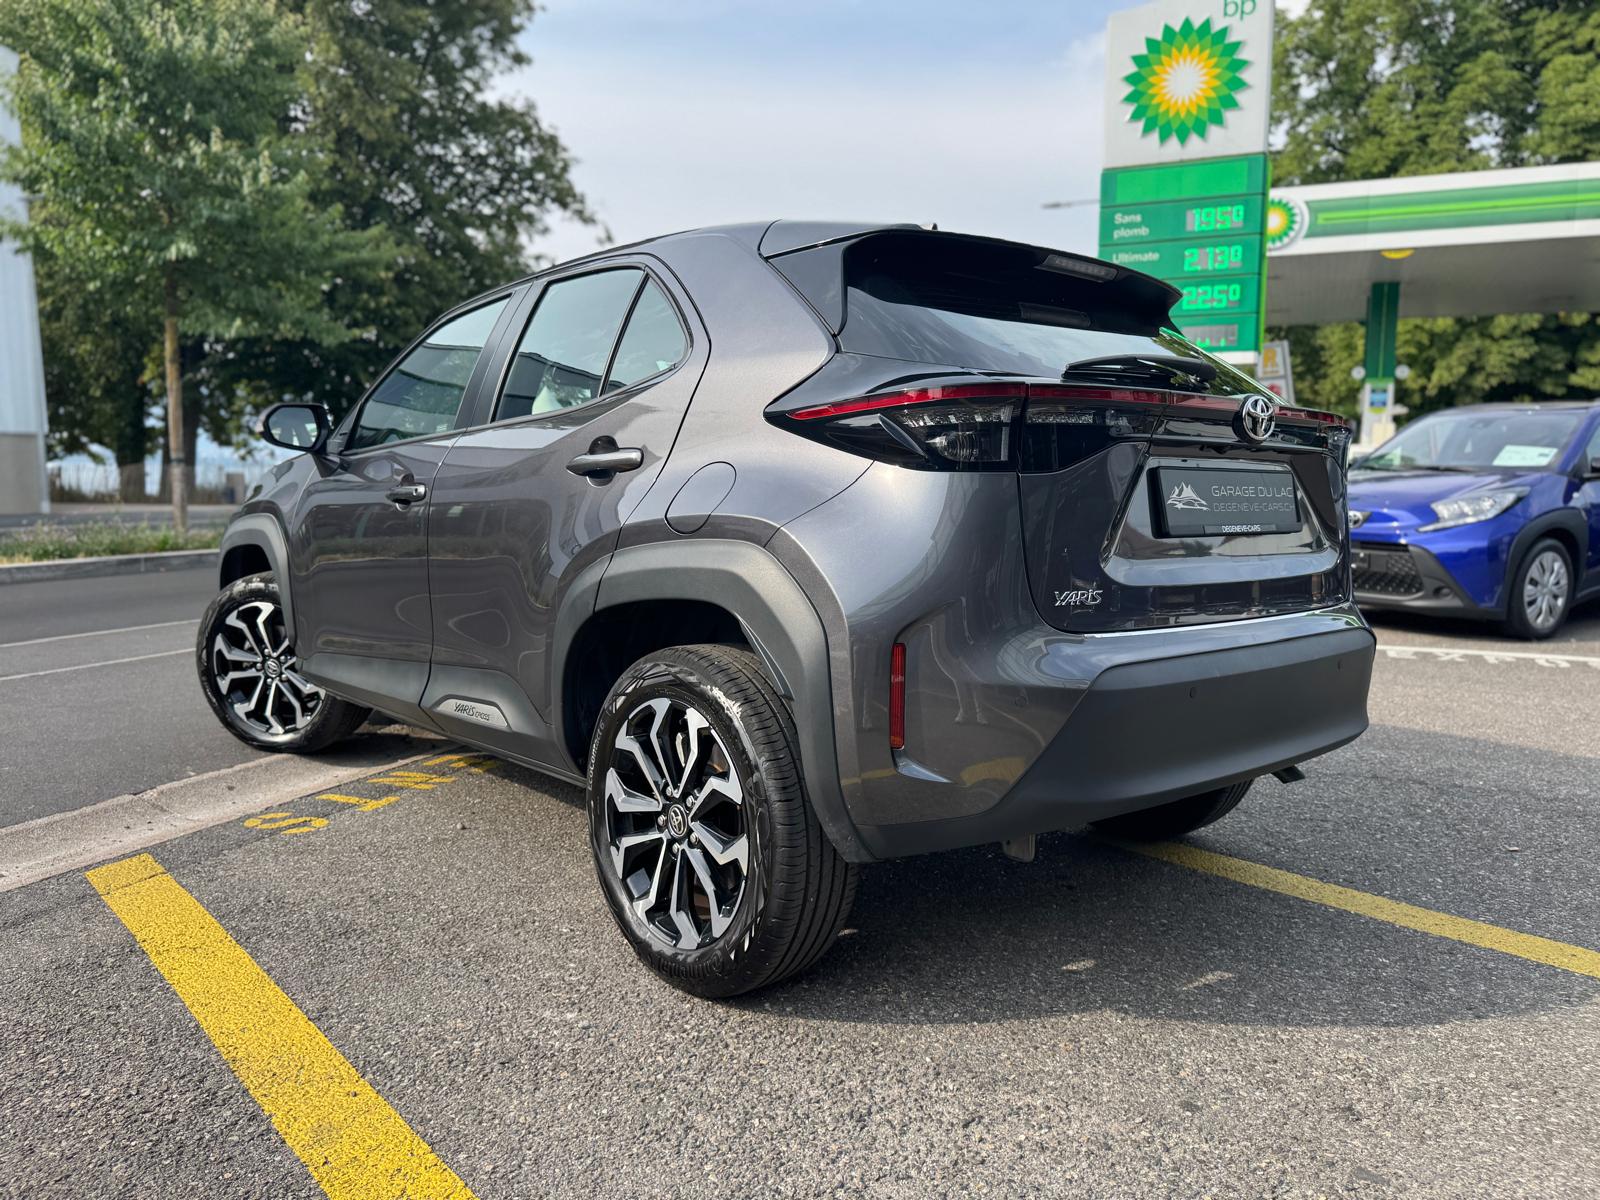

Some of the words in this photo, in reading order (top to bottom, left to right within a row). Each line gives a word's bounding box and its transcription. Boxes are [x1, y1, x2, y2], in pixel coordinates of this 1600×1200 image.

[1223, 0, 1256, 21] bp
[1114, 213, 1142, 224] Sans
[1113, 226, 1150, 240] plomb
[1112, 252, 1160, 265] Ultimate
[1211, 485, 1256, 497] GARAGE
[1258, 487, 1273, 497] DU
[1274, 487, 1293, 498] LAC
[1221, 525, 1261, 533] DEGENEVE-CARS
